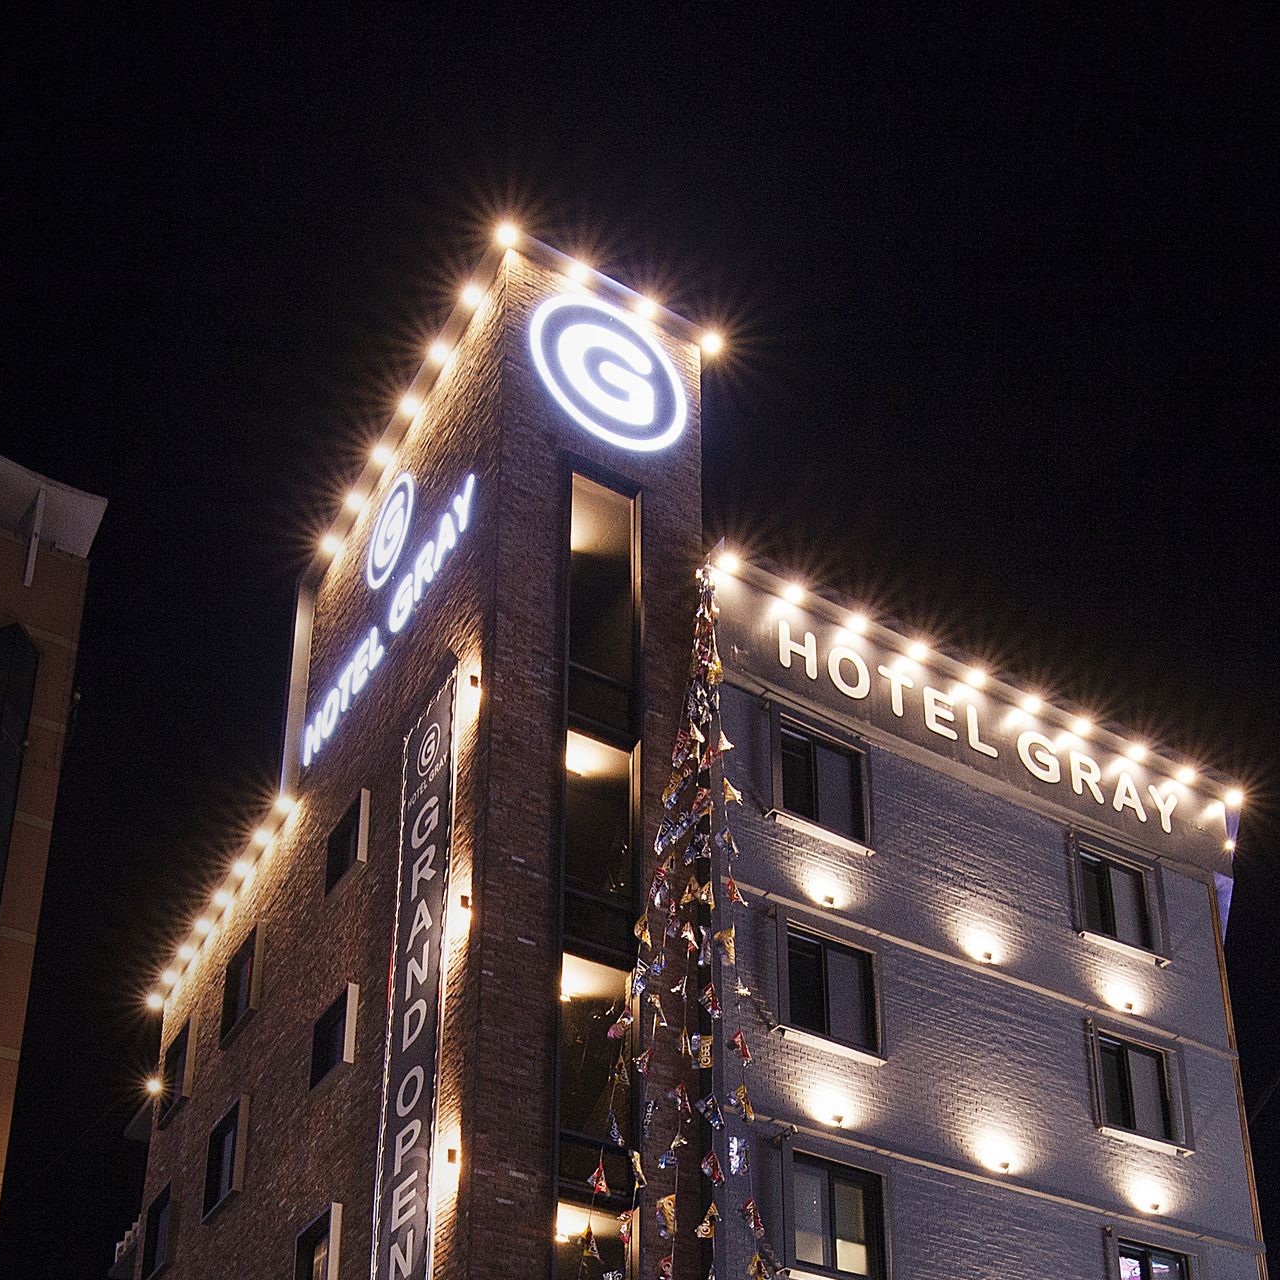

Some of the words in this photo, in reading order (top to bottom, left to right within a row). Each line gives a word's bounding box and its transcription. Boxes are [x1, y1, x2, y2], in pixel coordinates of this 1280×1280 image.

[558, 323, 653, 425] G
[303, 627, 384, 766] HOTEL
[389, 473, 475, 632] GRAY
[778, 618, 999, 759] HOTEL
[1016, 730, 1178, 834] GRAY
[407, 781, 428, 810] HOTEL
[428, 751, 449, 782] GRAY
[402, 797, 440, 1053] GRAND
